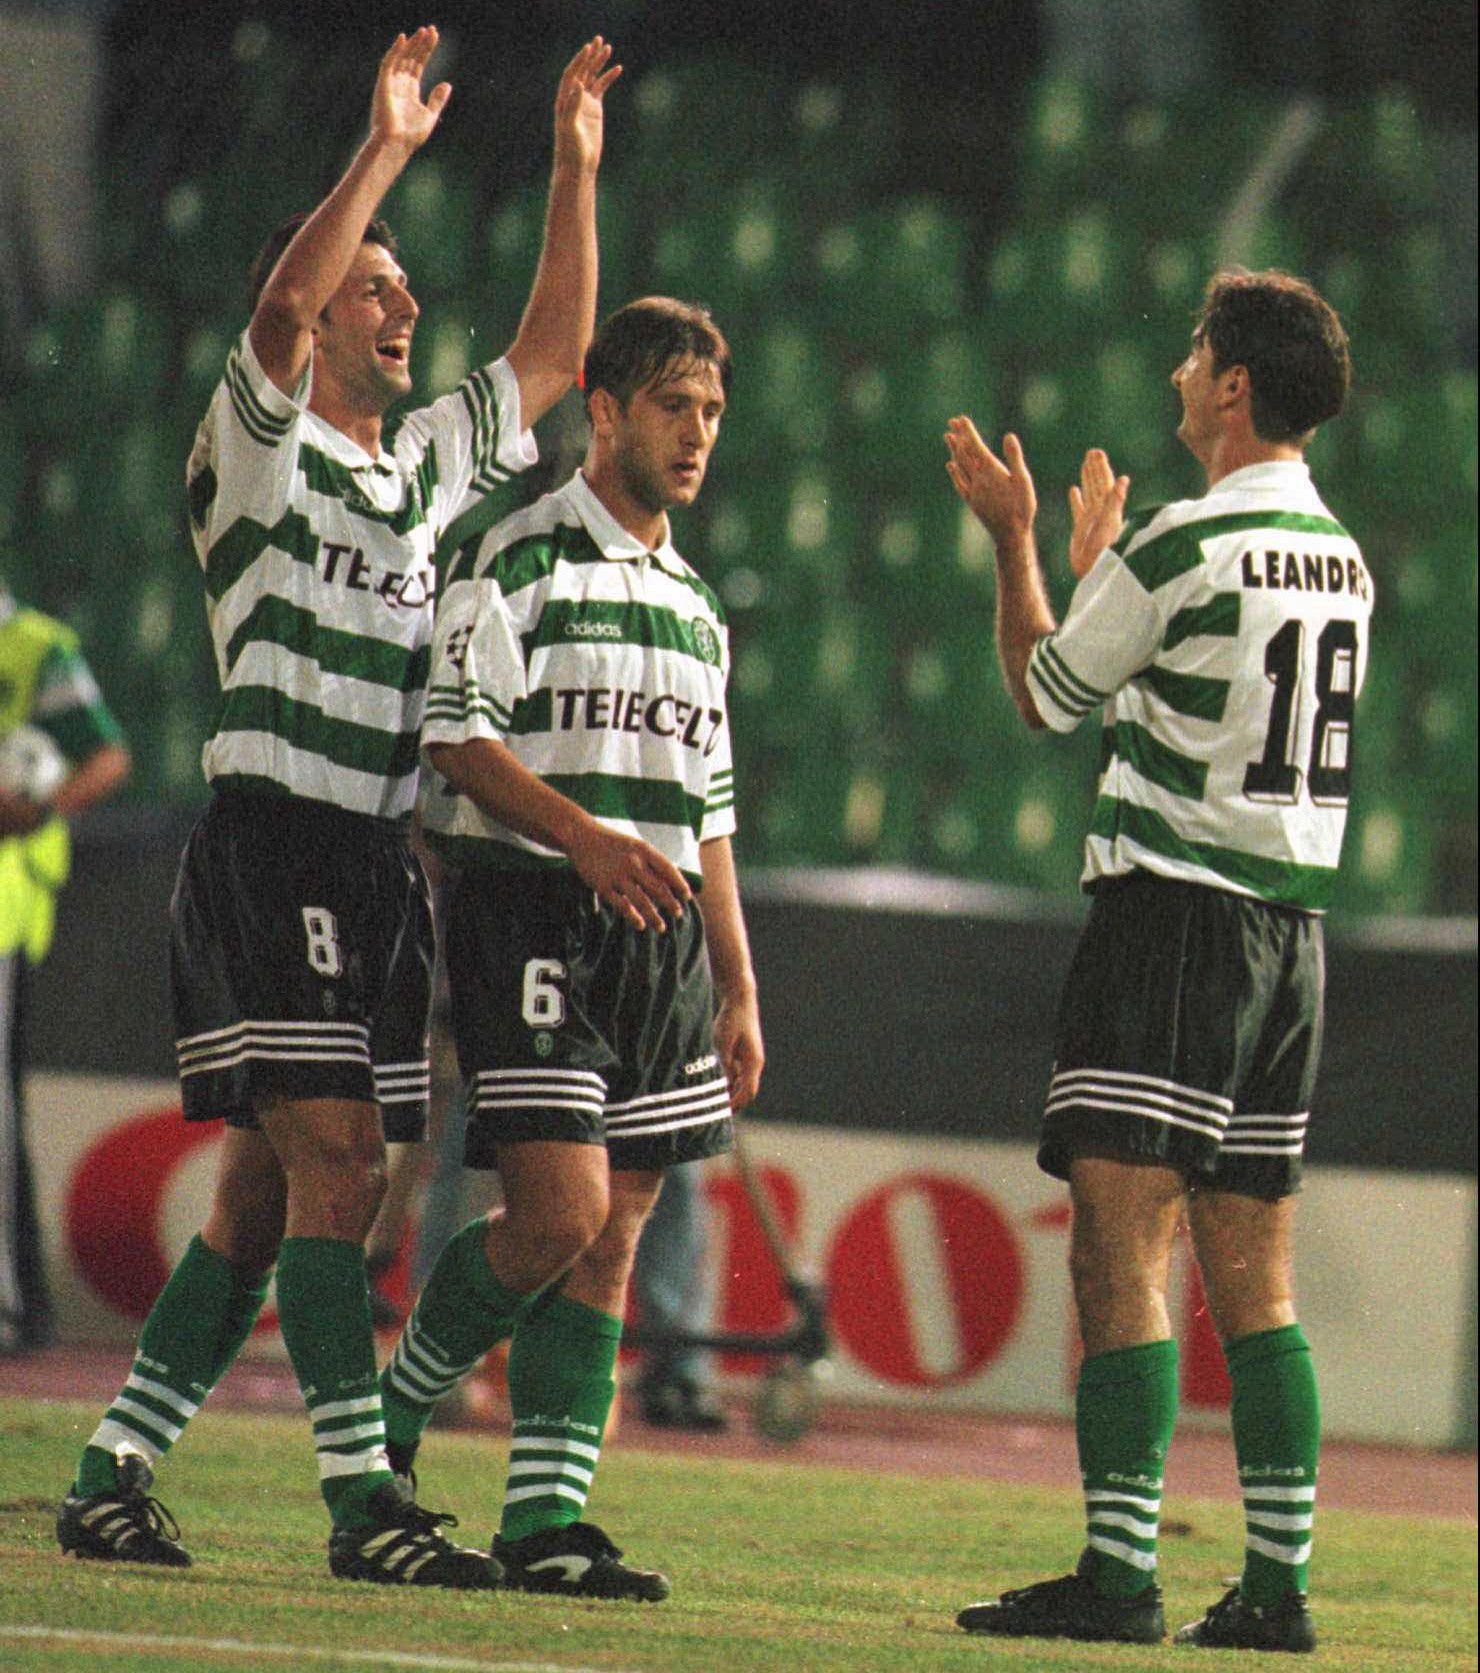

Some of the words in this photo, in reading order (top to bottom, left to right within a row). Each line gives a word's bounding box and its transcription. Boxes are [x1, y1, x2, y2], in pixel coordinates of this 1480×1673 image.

[564, 620, 623, 638] adidas
[1242, 619, 1358, 806] 18
[302, 907, 342, 979] 8
[522, 958, 566, 1029] 6
